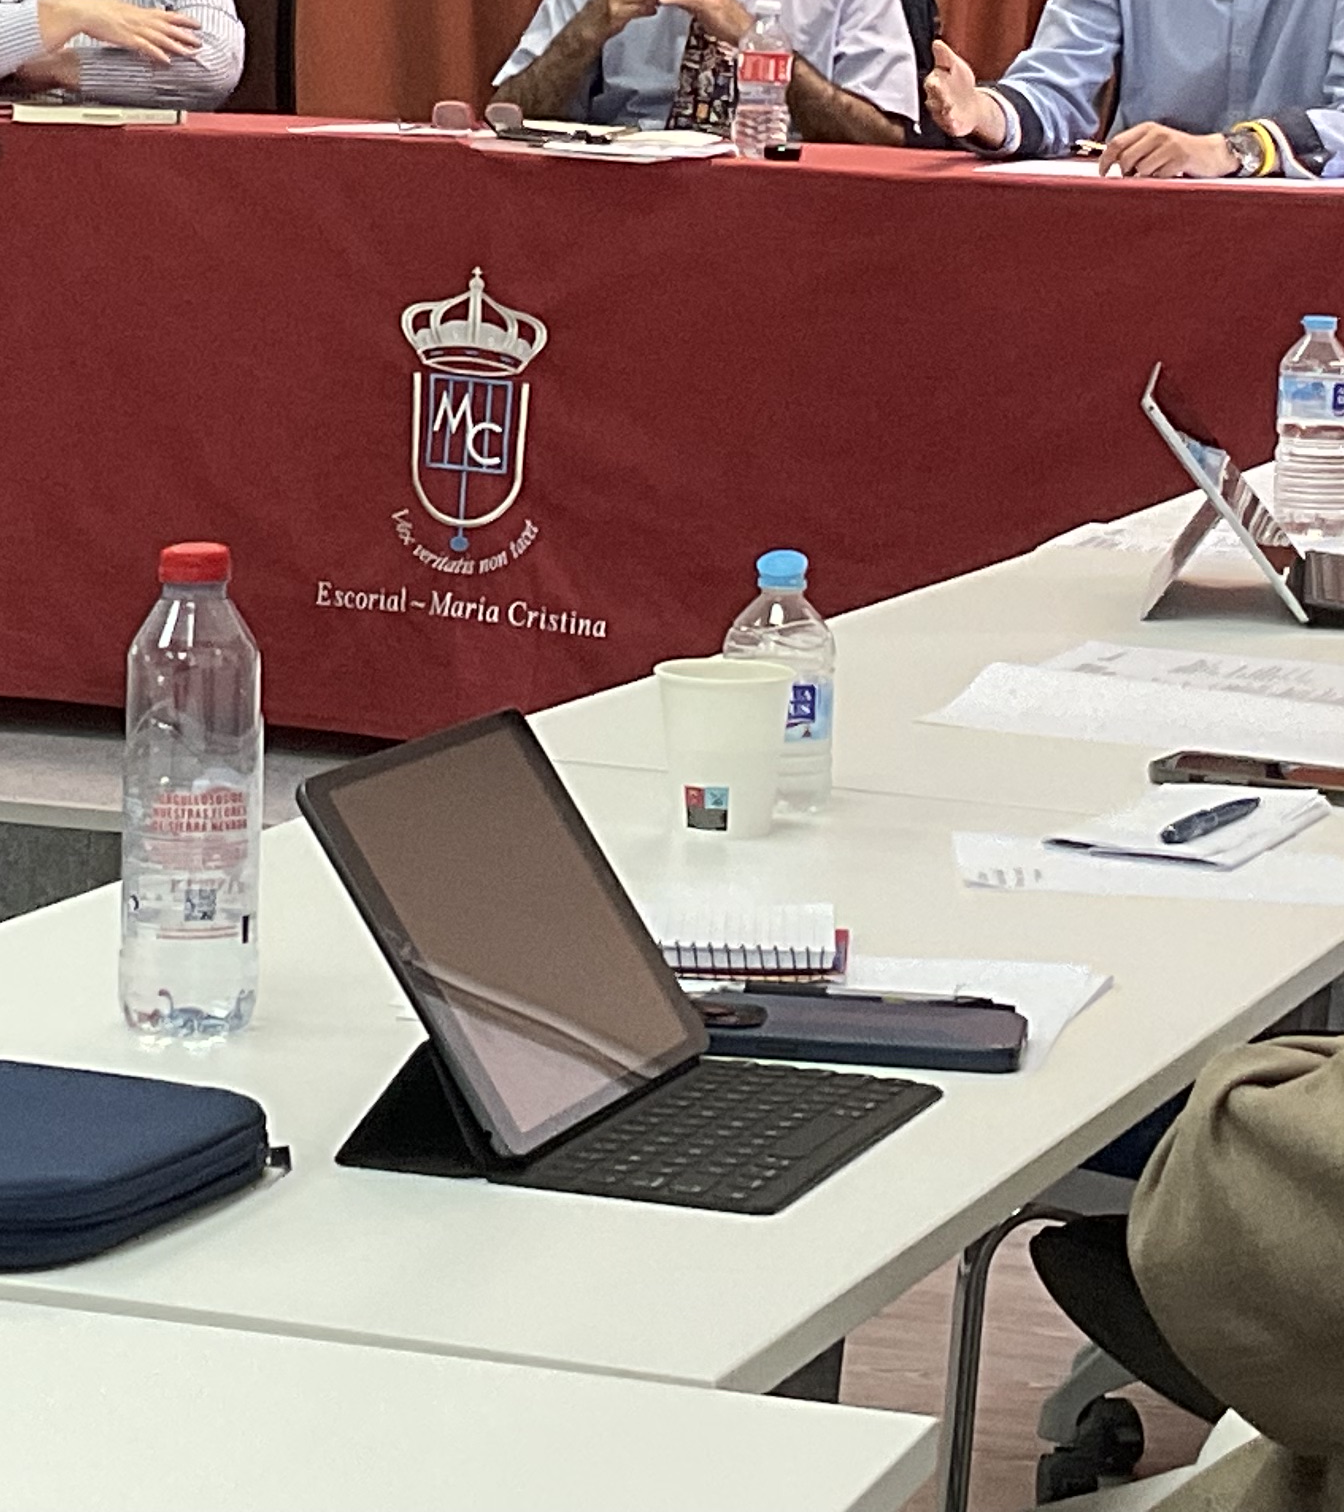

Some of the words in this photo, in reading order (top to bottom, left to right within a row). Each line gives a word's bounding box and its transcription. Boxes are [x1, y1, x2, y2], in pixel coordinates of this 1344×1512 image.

[433, 390, 503, 466] MC
[479, 550, 509, 574] non
[316, 581, 407, 613] Escorial
[429, 591, 500, 624] Maria
[507, 601, 608, 639] Cristina
